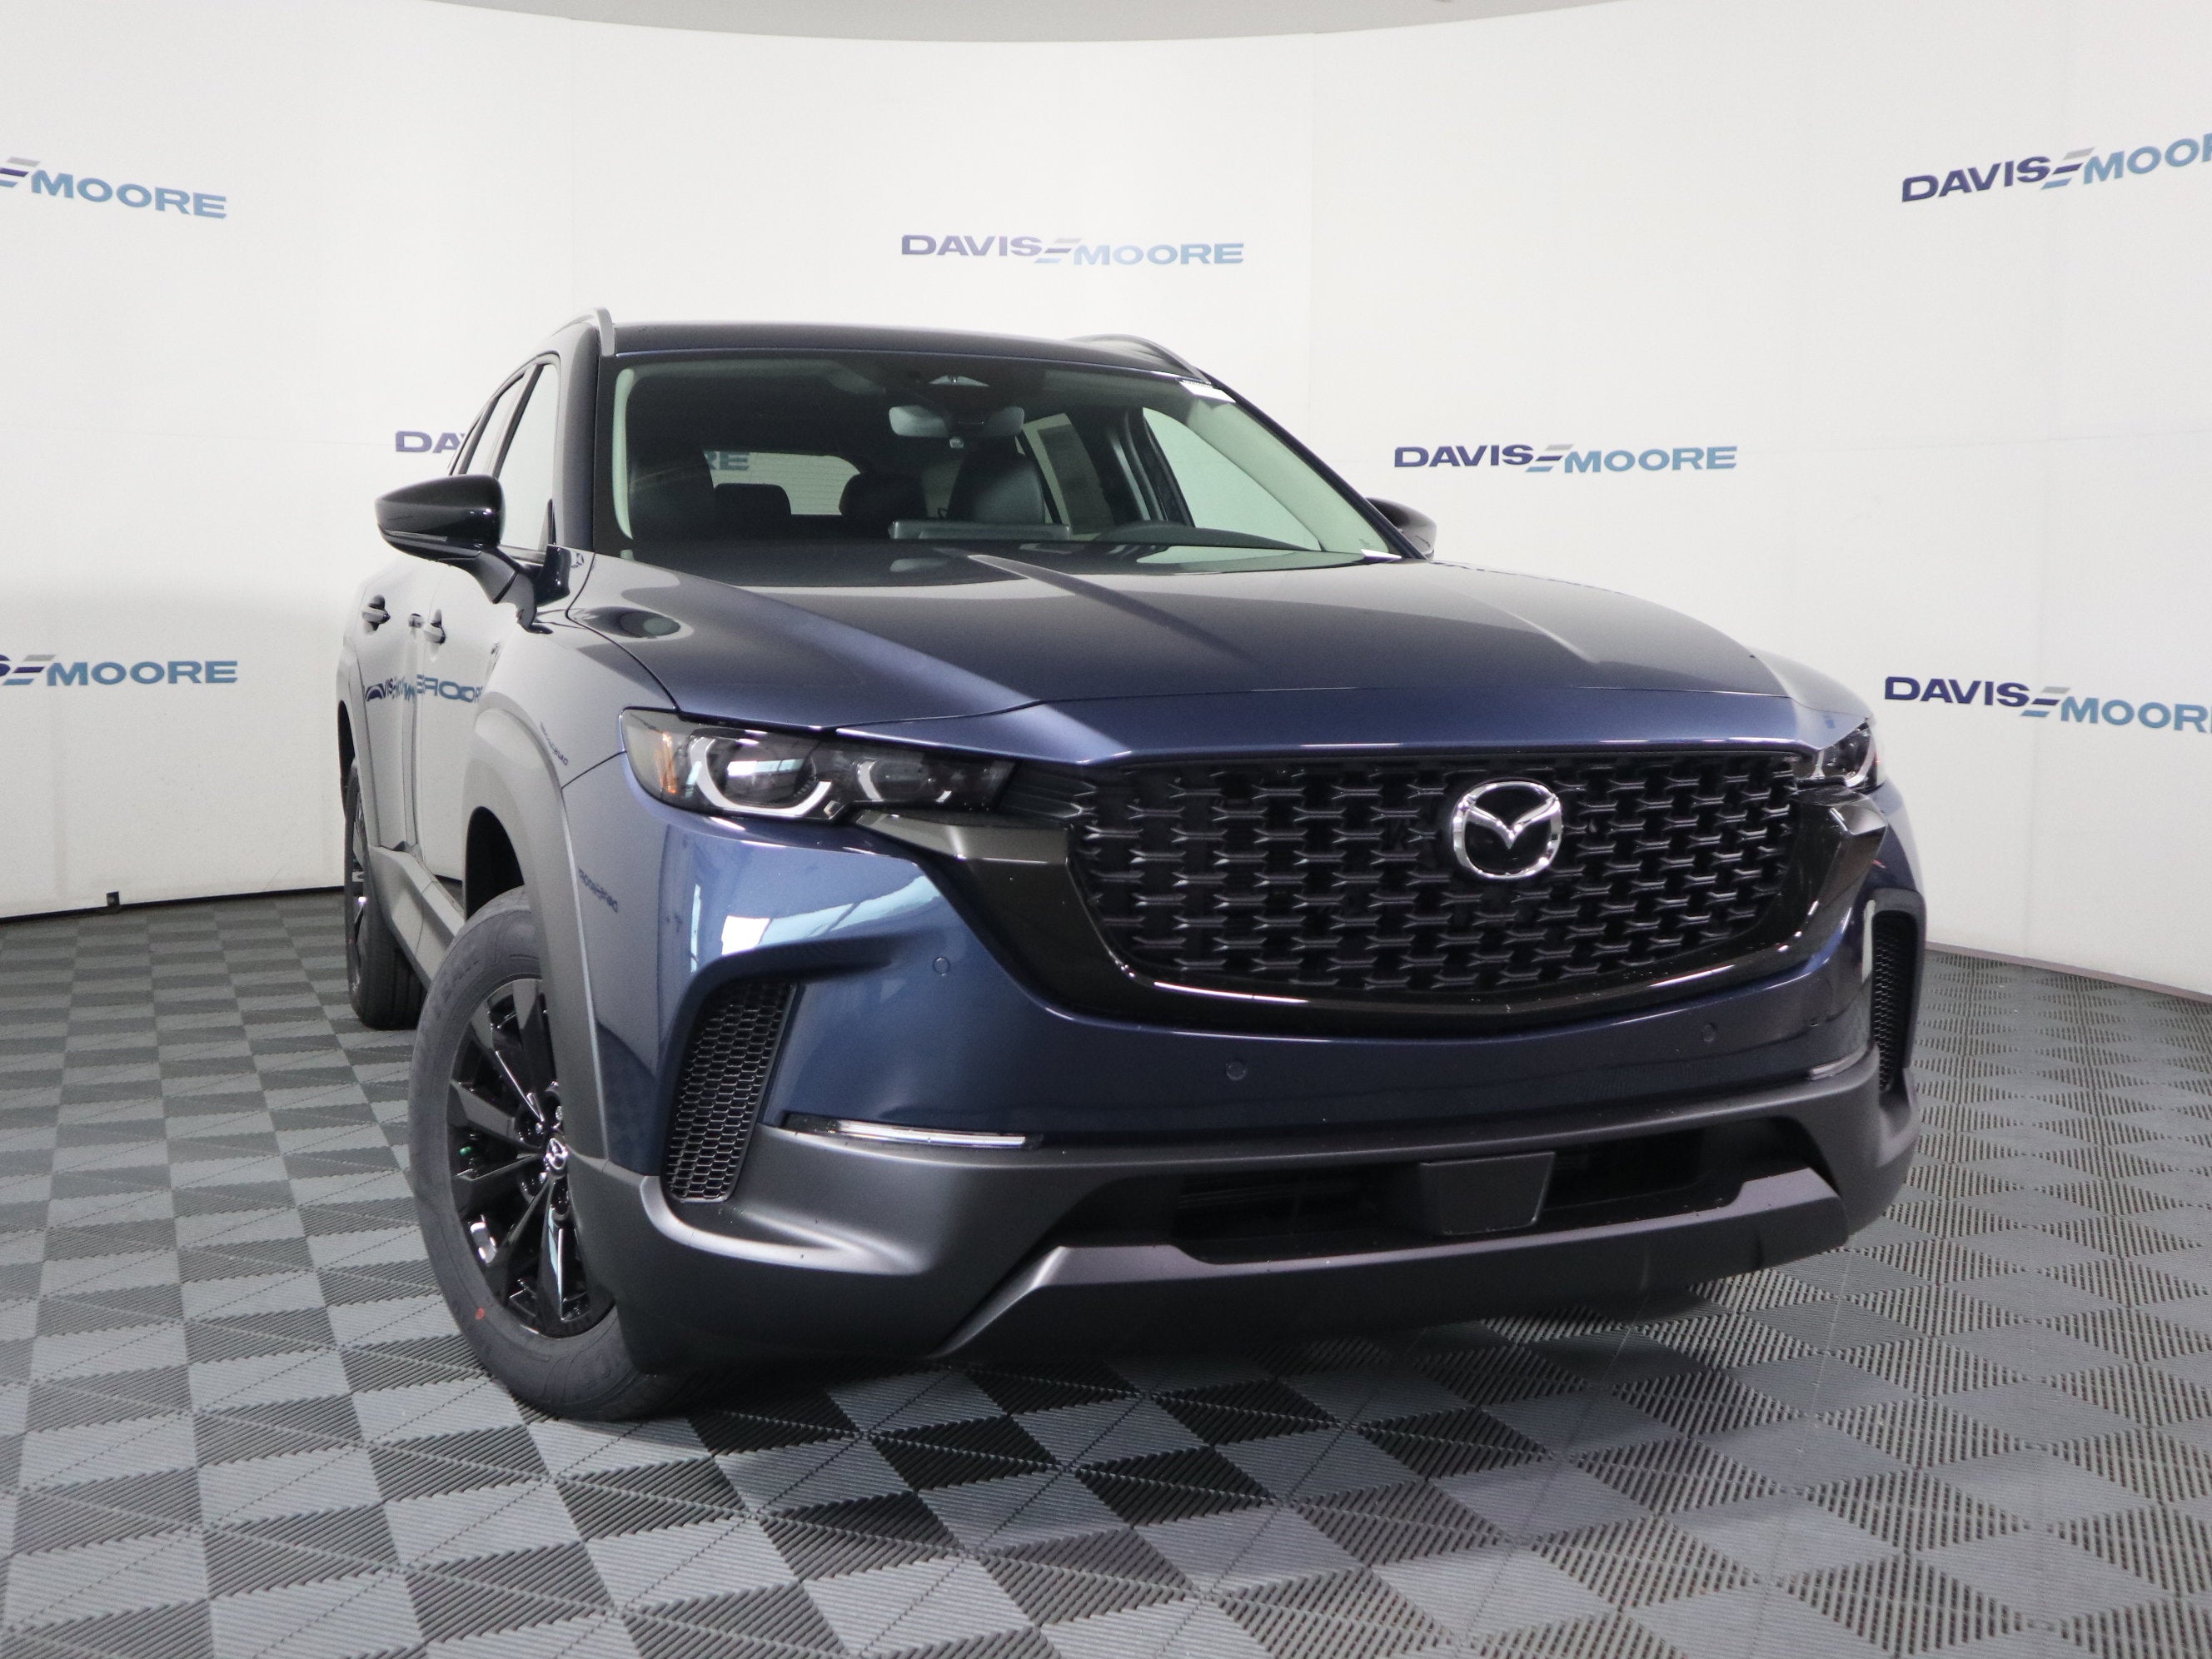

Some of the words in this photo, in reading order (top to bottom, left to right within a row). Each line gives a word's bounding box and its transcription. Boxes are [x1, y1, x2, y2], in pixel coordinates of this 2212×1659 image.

[1902, 157, 2050, 202] DAVIS
[2084, 133, 2212, 184] MOO
[31, 170, 227, 219] MOORE
[902, 235, 1042, 257] DAVIS
[1074, 243, 1243, 265] MOORE
[396, 431, 466, 453] DA
[1394, 444, 1534, 467] DAVIS
[1564, 446, 1737, 473] MOORE
[47, 660, 237, 686] MOORE
[1885, 676, 2030, 707] DAVIS
[2061, 696, 2212, 733] MOOR
